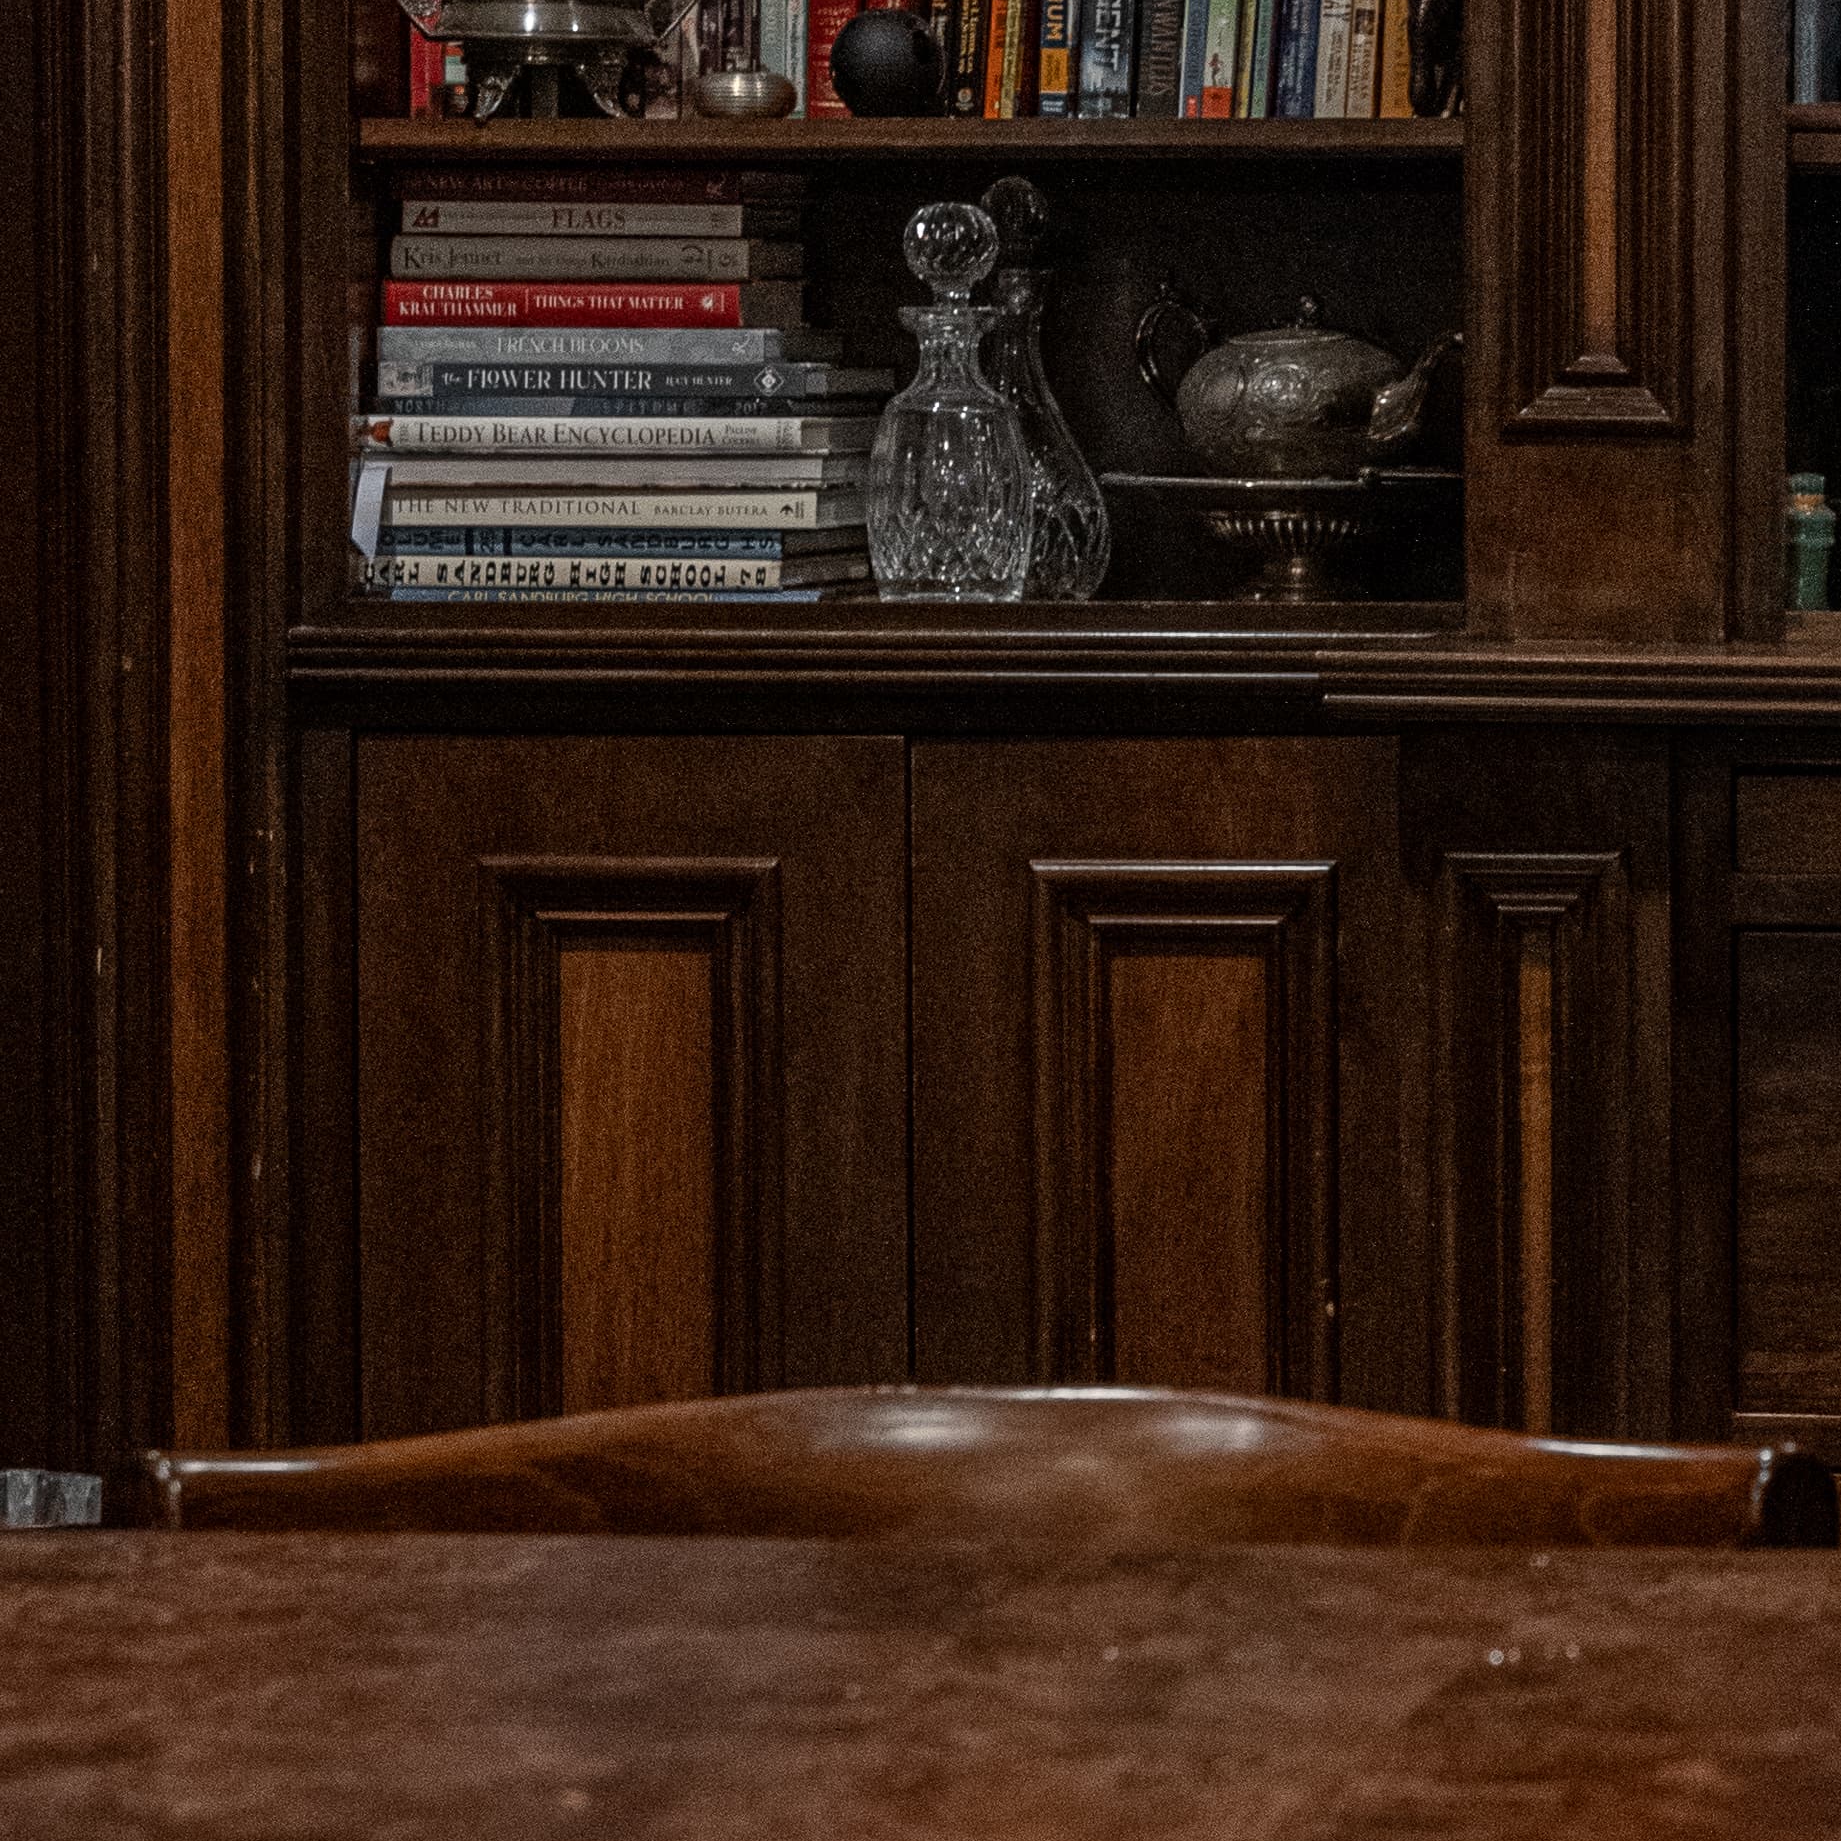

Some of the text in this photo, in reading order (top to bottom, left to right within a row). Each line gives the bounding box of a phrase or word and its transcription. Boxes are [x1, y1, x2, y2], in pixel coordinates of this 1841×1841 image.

[550, 208, 626, 230] FLAGS
[403, 246, 444, 269] Kris
[421, 285, 494, 300] CHARLES
[398, 300, 518, 317] KRAUTHAMMER
[534, 295, 684, 311] THINGS THAT MATTER
[497, 336, 569, 354] FRENCH
[570, 337, 645, 354] BLOOMS
[441, 368, 652, 390] the FLOWER HUNTER
[692, 375, 733, 387] HUNTER
[418, 422, 717, 447] TEDDY BEAR ENCYCLOPEDIA
[398, 498, 641, 516] THE NEW TRADITIONAL
[654, 505, 769, 517] BARCLAY BUTERA
[520, 532, 730, 550] CARL SANDBURG
[364, 560, 726, 589] CARL SANDBURG HIGH SCHOOL
[497, 590, 589, 603] SANDBURG
[595, 590, 638, 603] HIGH
